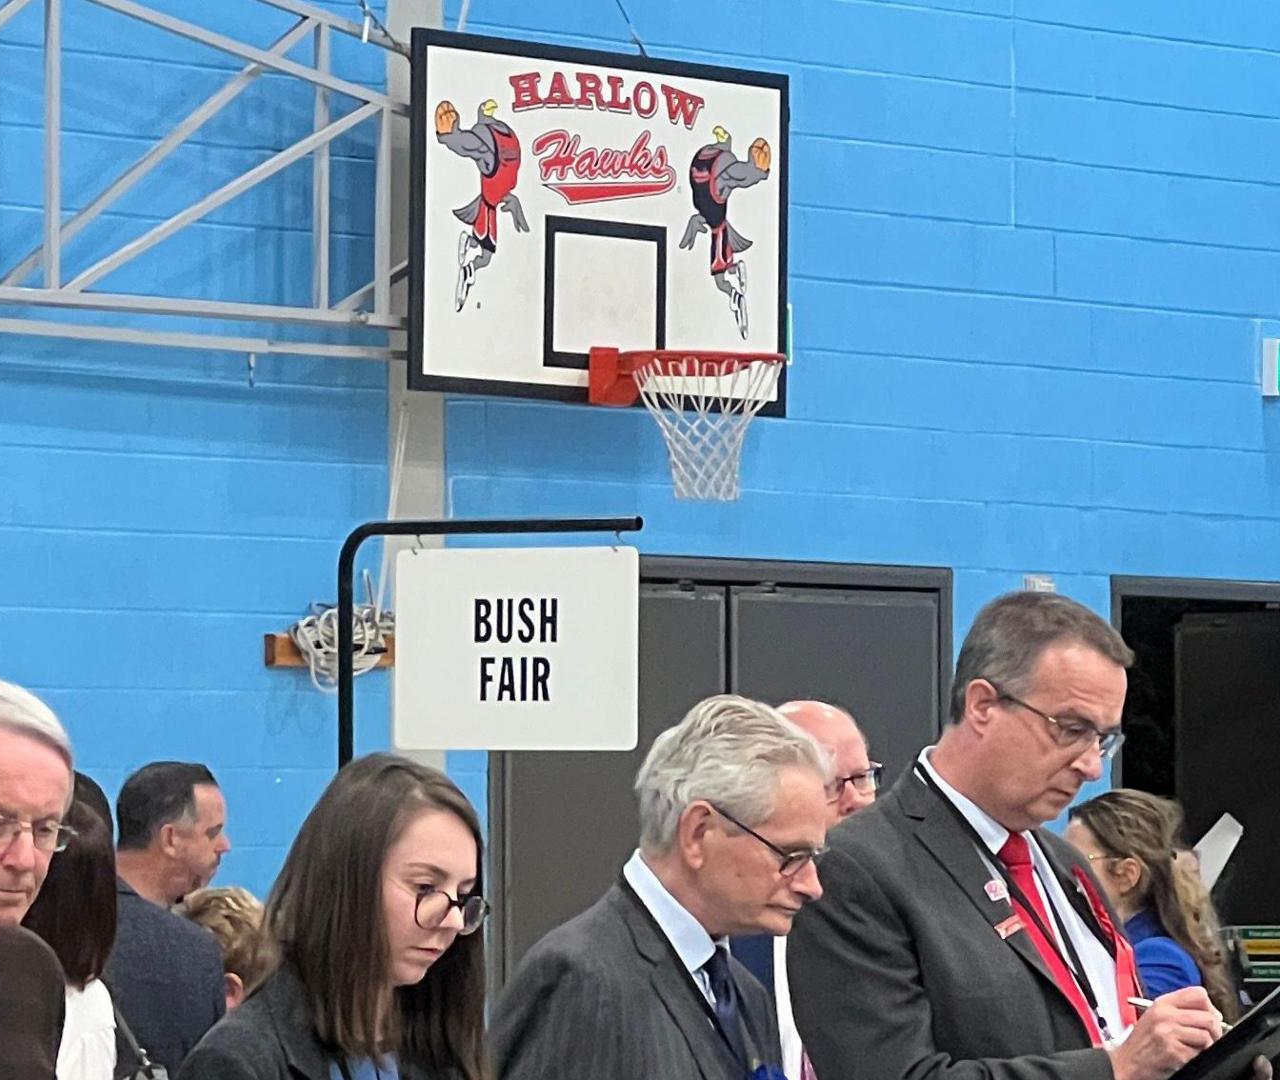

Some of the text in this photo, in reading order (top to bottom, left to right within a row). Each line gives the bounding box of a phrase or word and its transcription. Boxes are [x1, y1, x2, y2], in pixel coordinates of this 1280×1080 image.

[508, 71, 705, 131] HARLOW
[532, 129, 677, 184] Hawks
[474, 597, 558, 644] BUSH
[479, 656, 551, 702] FAIR
